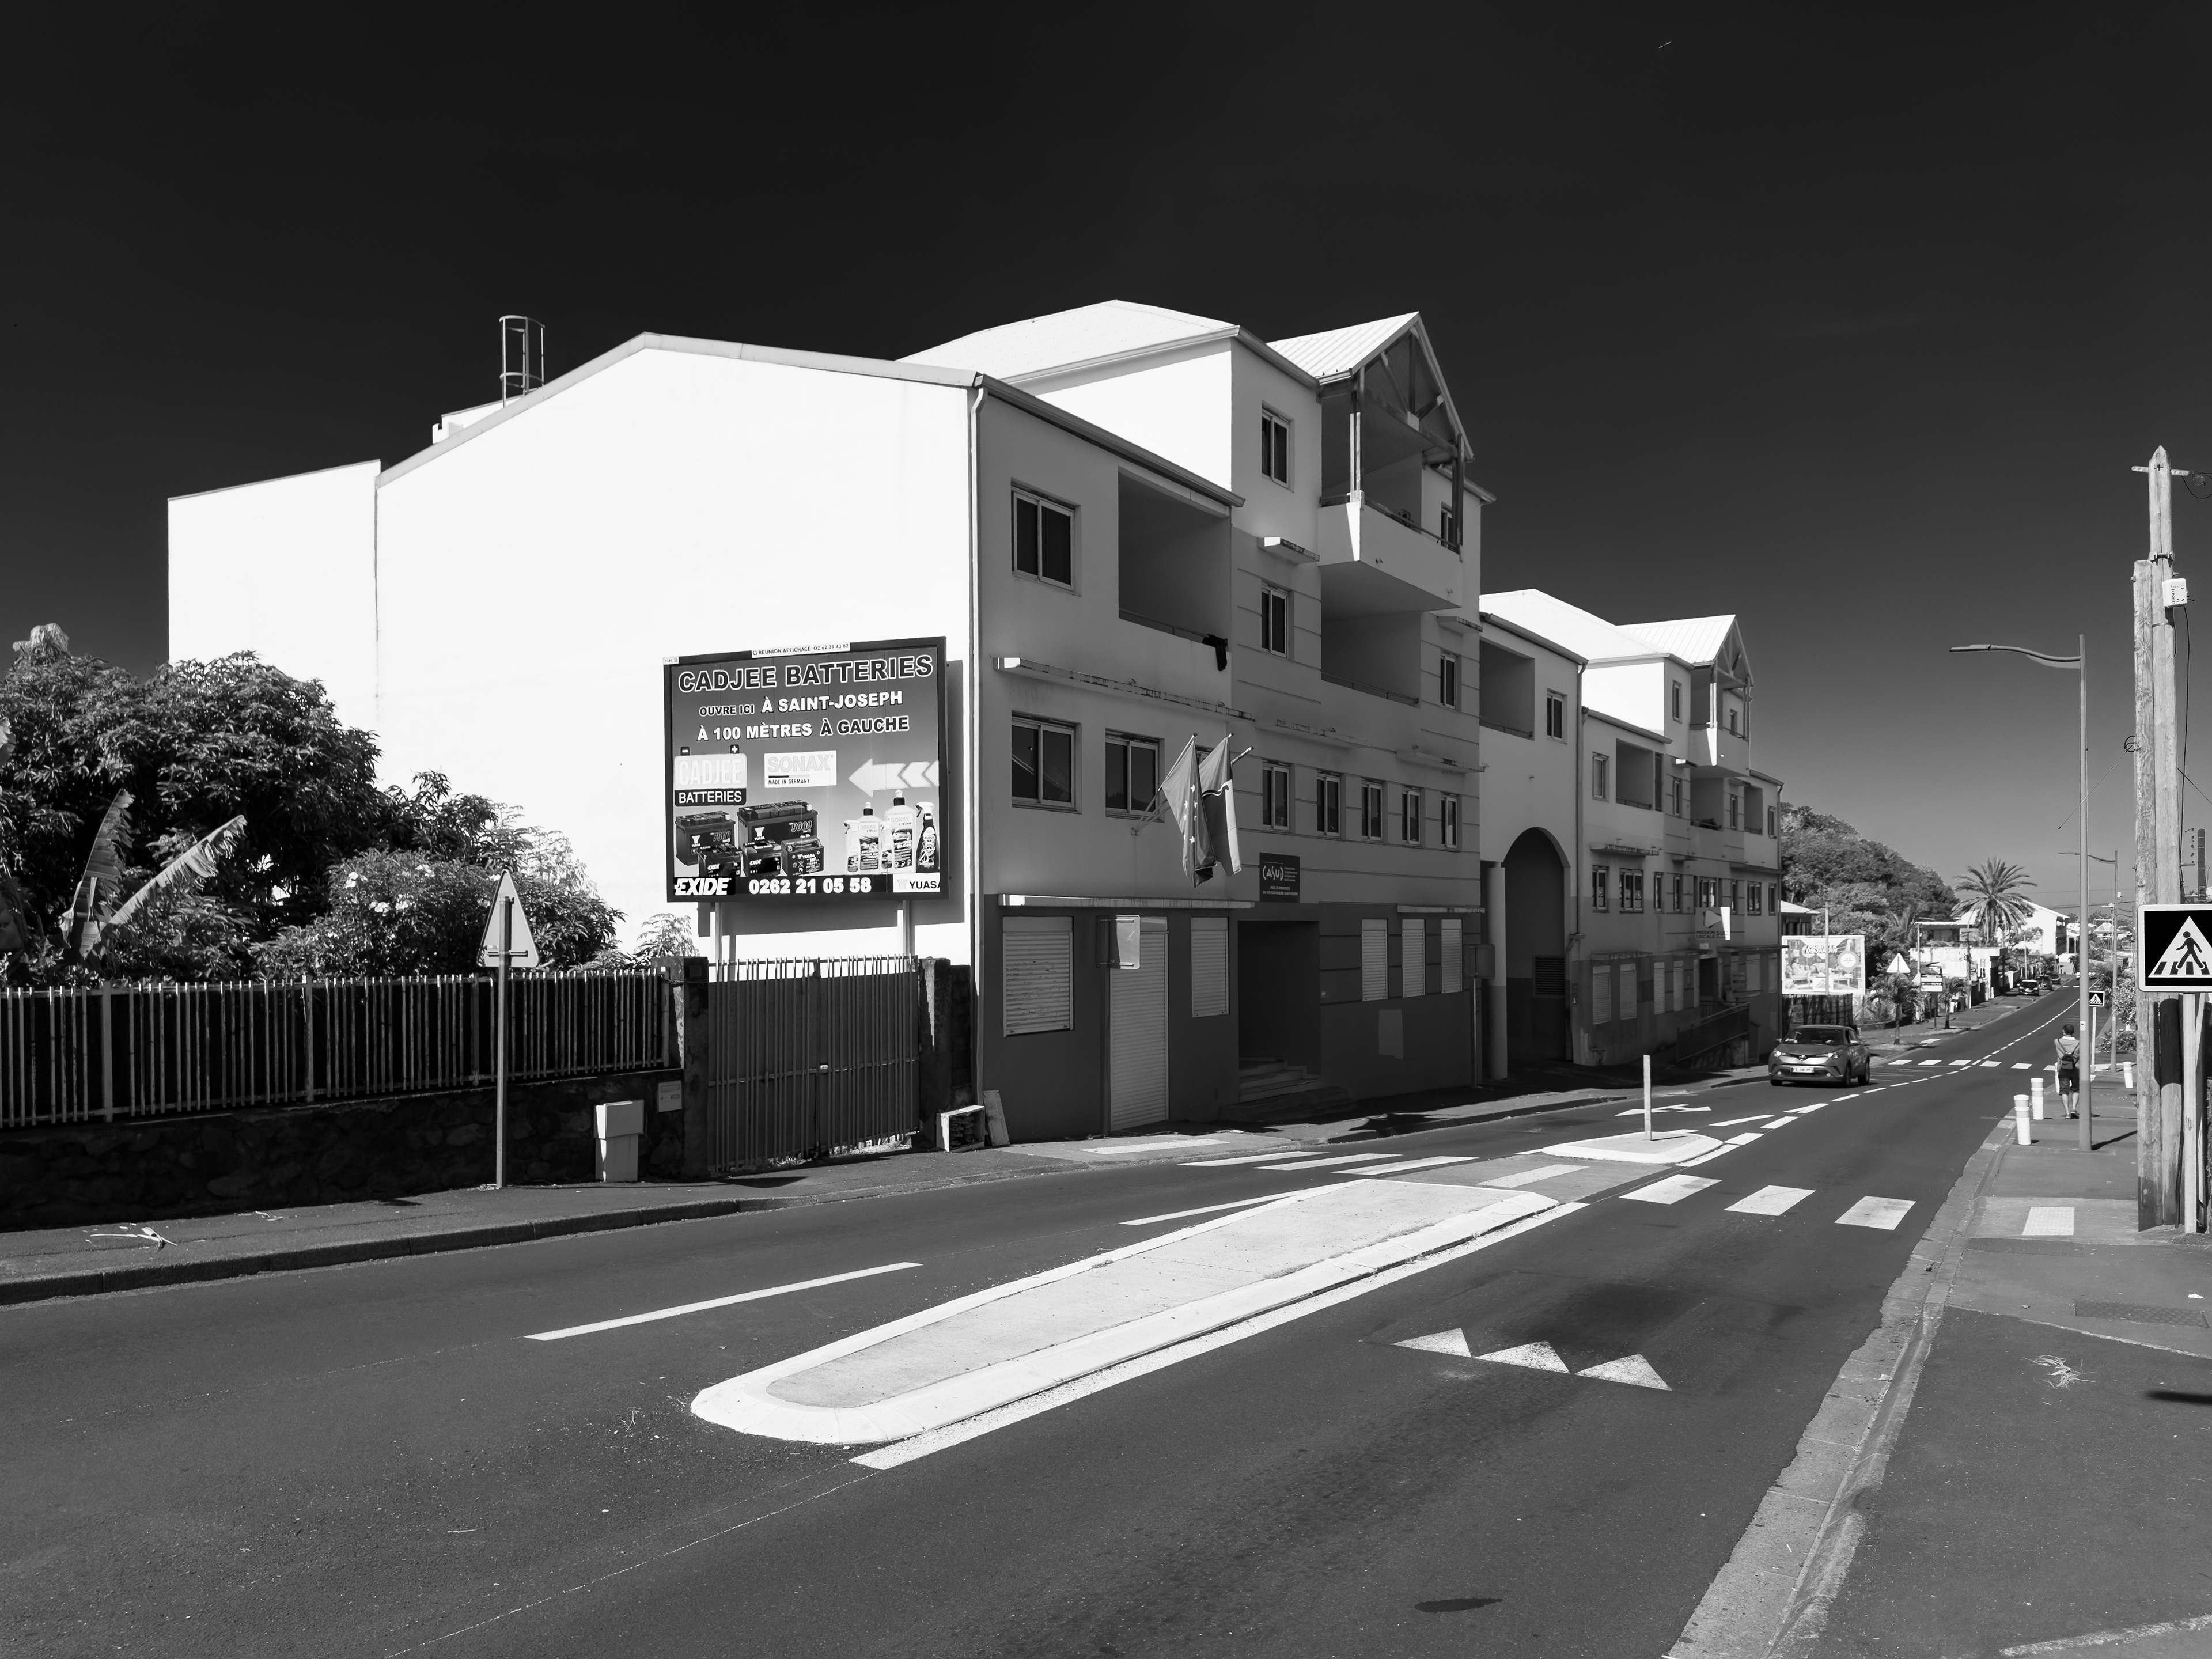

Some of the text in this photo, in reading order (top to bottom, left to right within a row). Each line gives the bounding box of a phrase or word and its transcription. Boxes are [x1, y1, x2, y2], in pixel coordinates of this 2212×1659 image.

[678, 654, 933, 693] CADJEE BATTERIES
[699, 690, 903, 717] OUVRE ICI À SAINT-JOSEPH
[697, 715, 910, 741] À 100 MÈTRES À GAUCHE
[679, 758, 743, 787] CADJEE
[678, 790, 743, 804] BATTERIES
[791, 820, 813, 832] 9000
[713, 830, 731, 842] 7000
[674, 877, 730, 896] EXIDE
[749, 877, 872, 895] 0262 21 05 58
